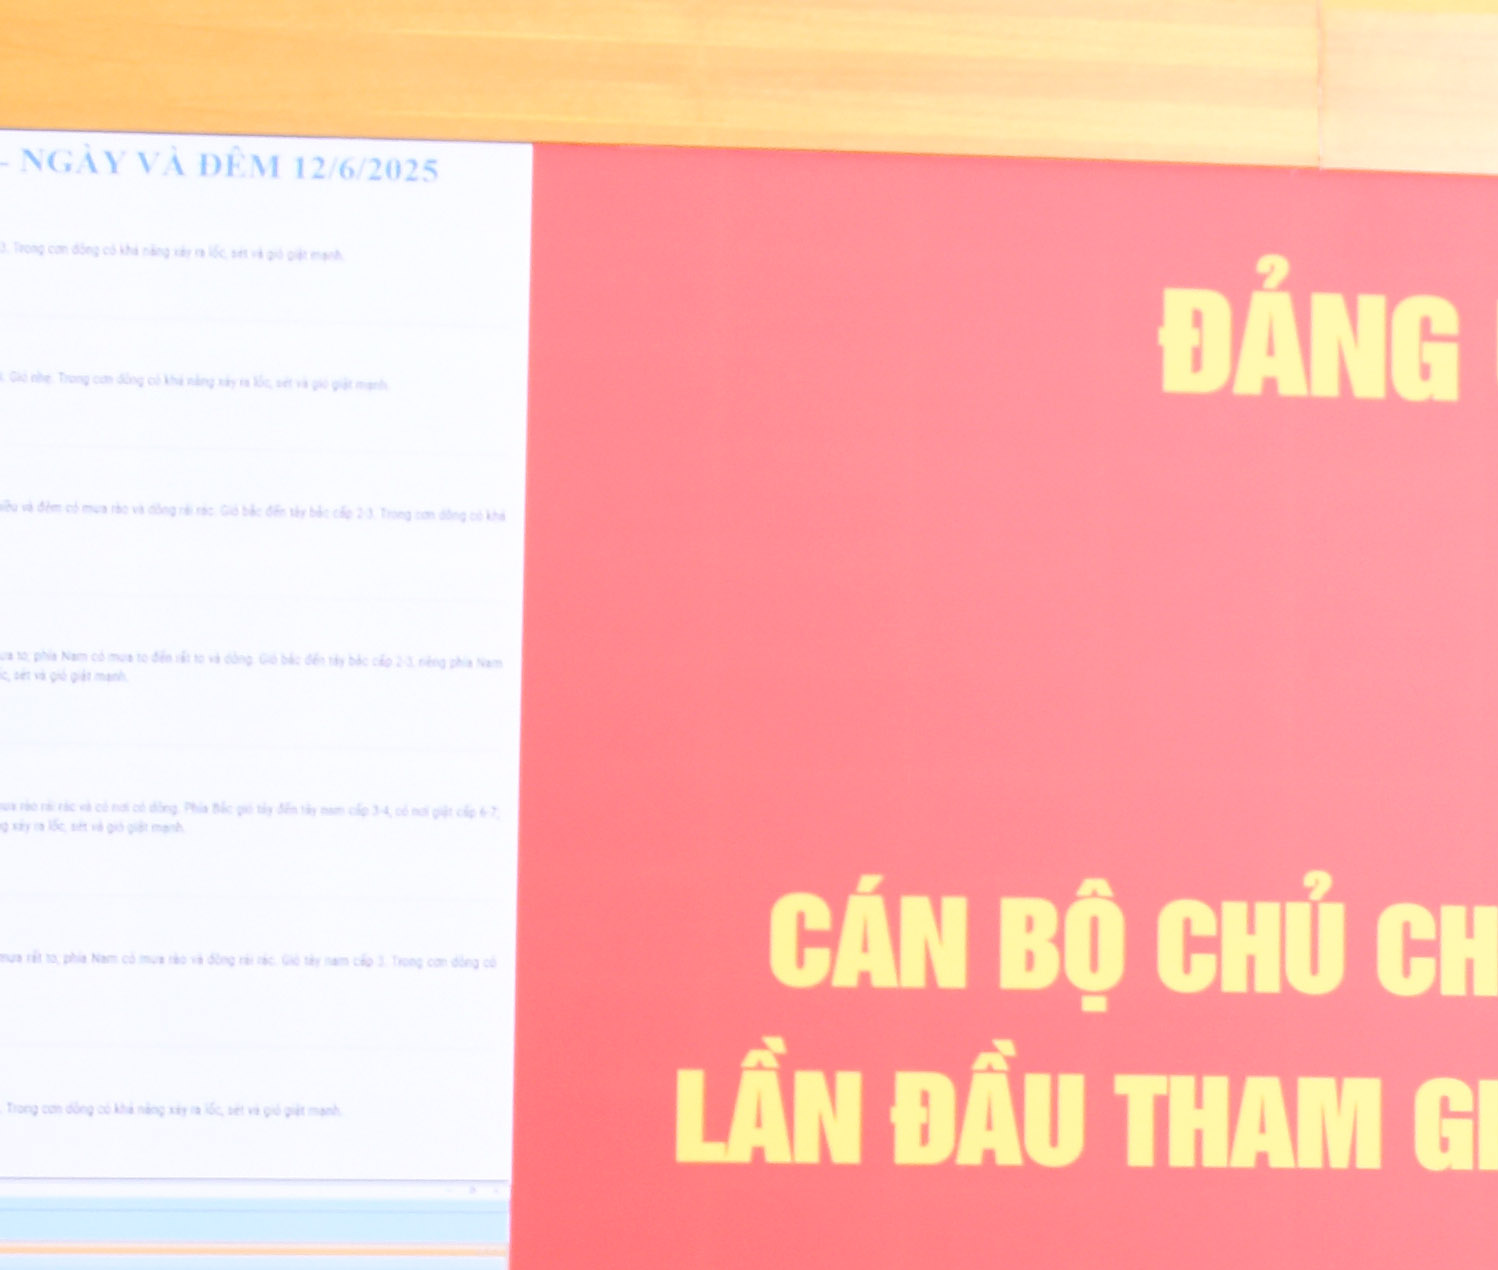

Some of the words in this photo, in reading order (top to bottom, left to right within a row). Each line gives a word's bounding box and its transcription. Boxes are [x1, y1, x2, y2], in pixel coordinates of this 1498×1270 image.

[21, 143, 125, 174] NGÀY
[137, 146, 184, 176] VÀ
[199, 145, 279, 179] ĐÊM
[296, 155, 438, 182] 12/6/2025
[1158, 254, 1459, 402] ĐẢNG
[770, 875, 967, 988] CÁN
[1000, 878, 1125, 1012] BỘ
[1157, 872, 1345, 995] CHỦ
[676, 1037, 862, 1164] LẦN
[890, 1039, 1084, 1167] ĐẦU
[1114, 1074, 1382, 1169] THAM
